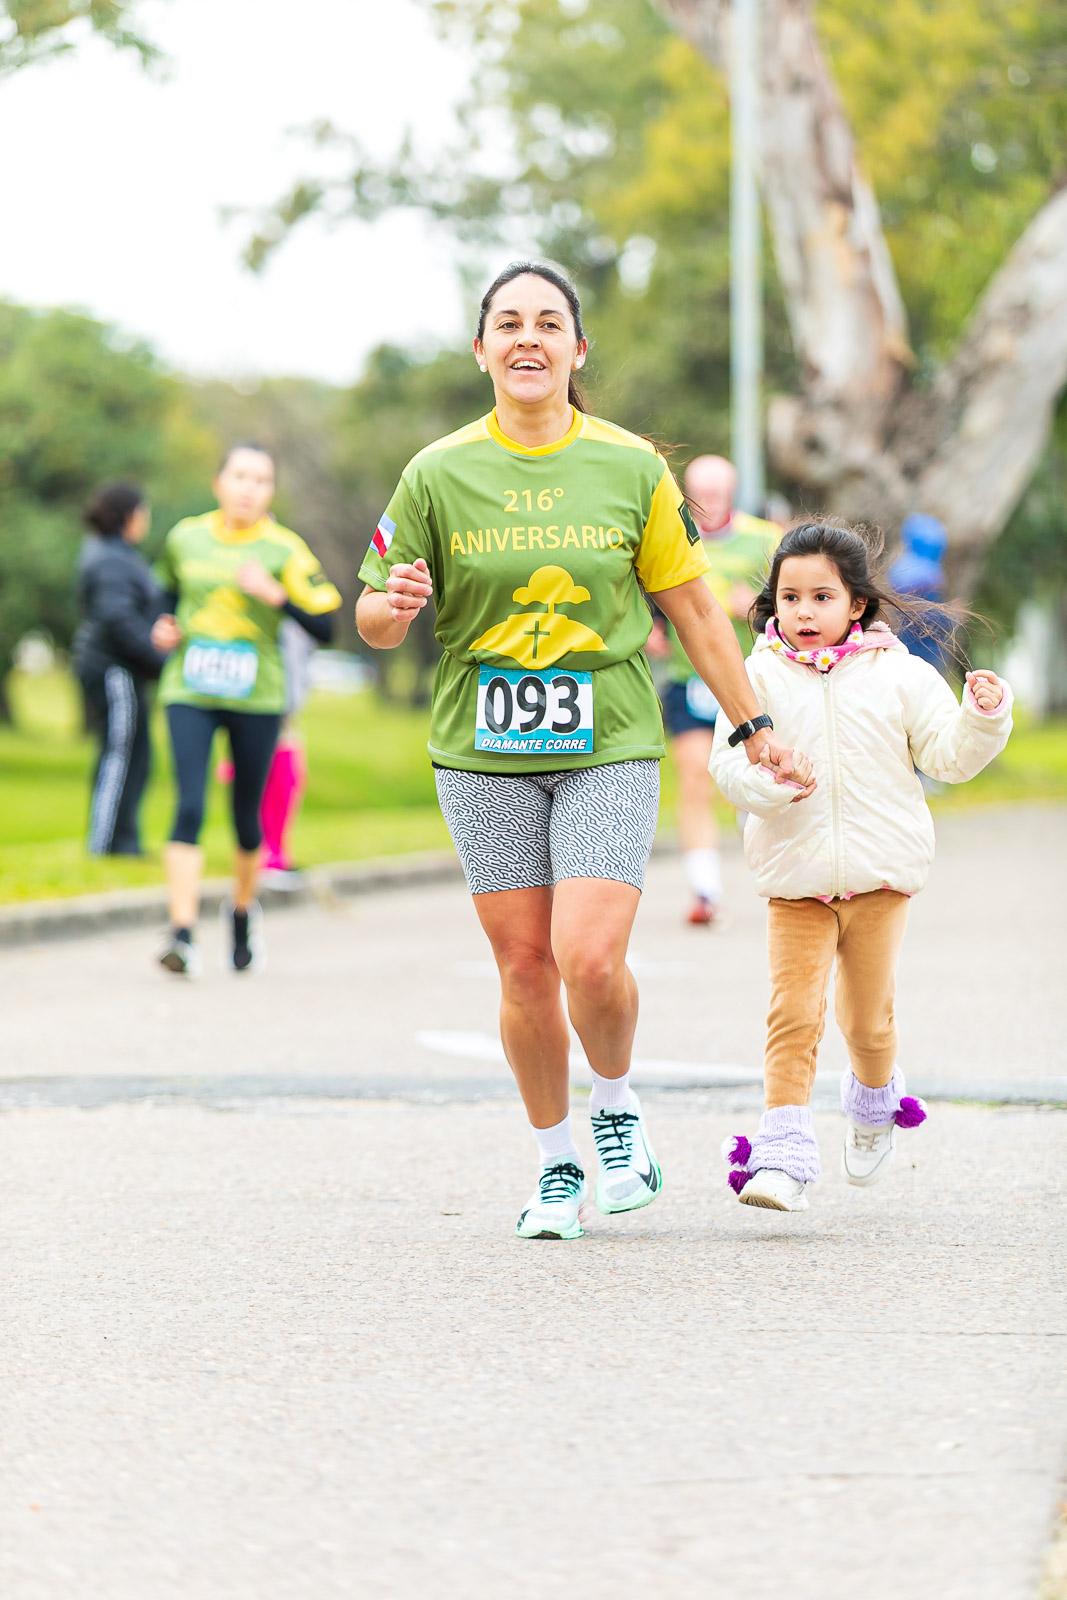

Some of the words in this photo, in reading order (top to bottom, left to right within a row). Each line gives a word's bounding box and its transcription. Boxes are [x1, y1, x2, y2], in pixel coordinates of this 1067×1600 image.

[503, 487, 565, 513] 216°
[450, 525, 624, 556] ANIVERSARIO
[484, 674, 582, 735] 093
[480, 738, 543, 751] DIAMANTE
[544, 738, 587, 751] CORRE
